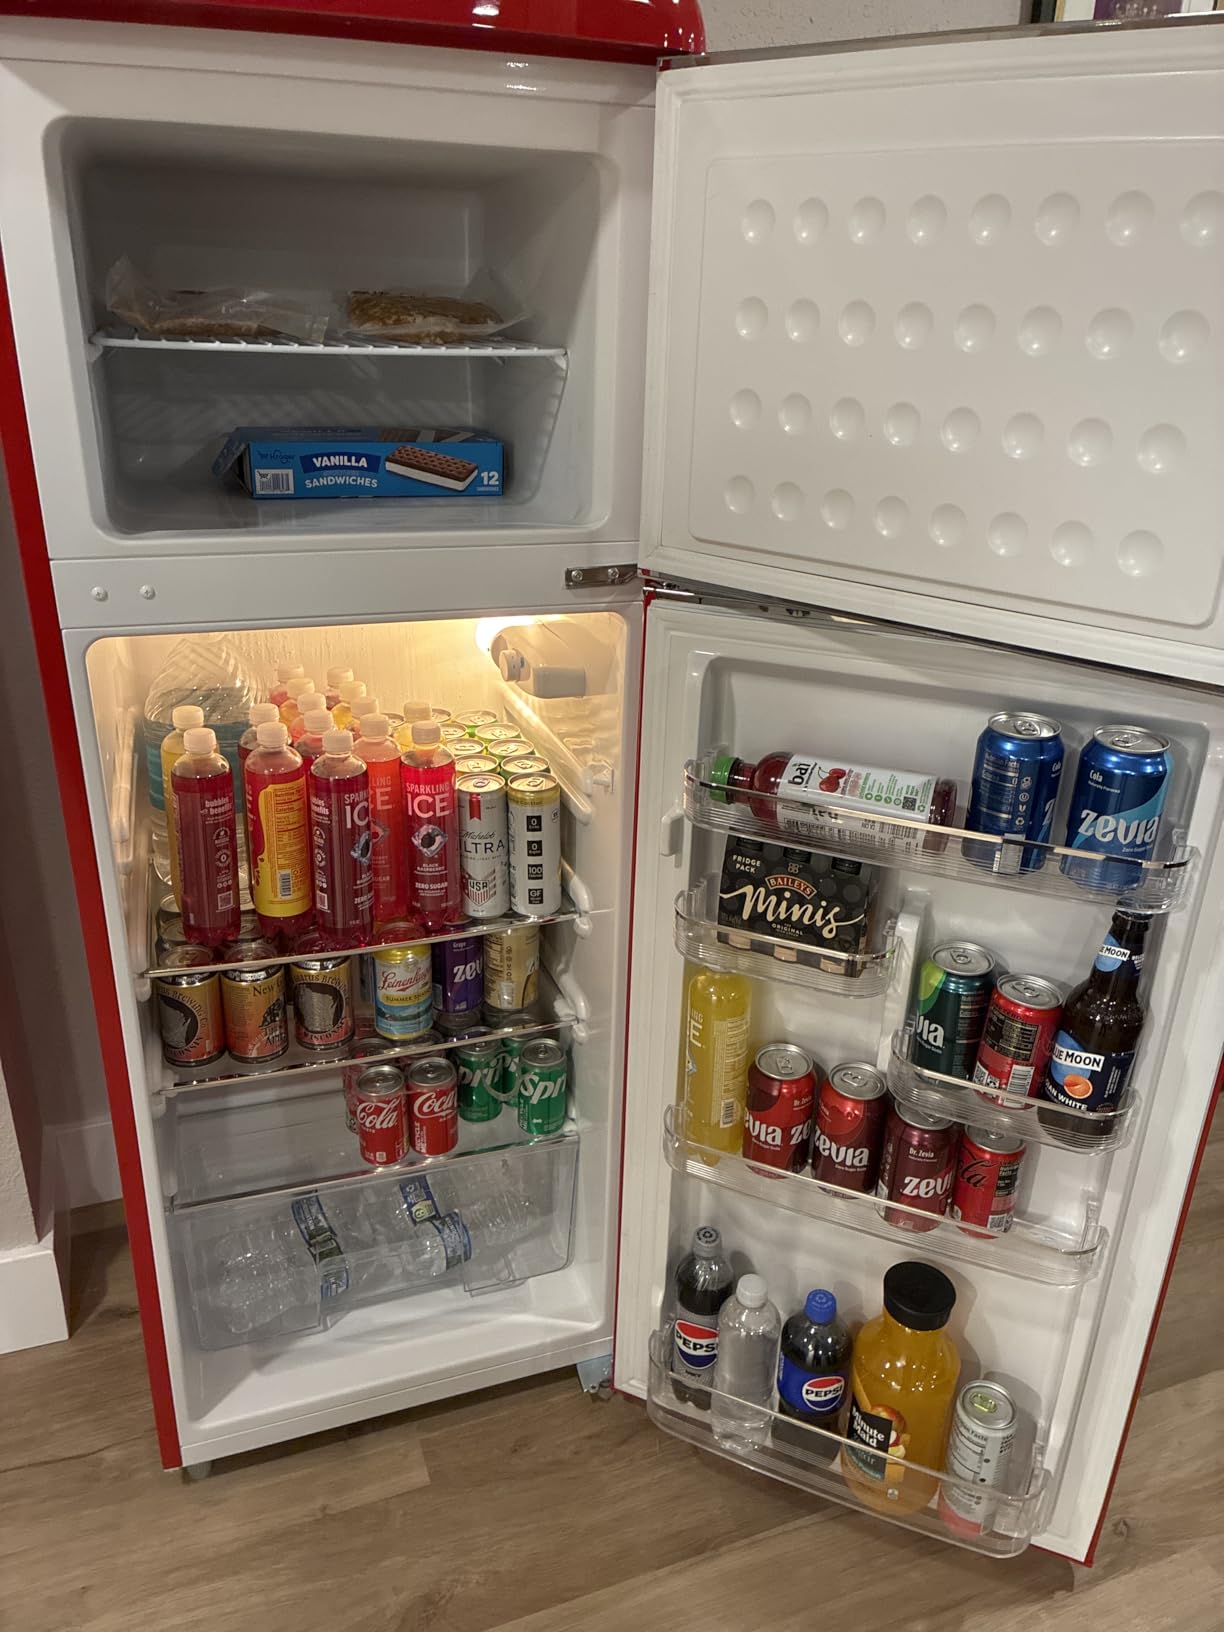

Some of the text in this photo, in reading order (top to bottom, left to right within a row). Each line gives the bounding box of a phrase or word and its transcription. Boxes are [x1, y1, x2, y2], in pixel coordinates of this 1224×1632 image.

[312, 455, 368, 468] VANILLA
[304, 476, 378, 488] SANDWICHES
[480, 471, 500, 486] 12
[788, 762, 811, 786] bai
[1089, 770, 1103, 782] Cola
[406, 782, 451, 798] SPARKLING
[407, 792, 451, 818] ICE
[344, 802, 370, 829] IC
[531, 818, 538, 826] 0
[1078, 808, 1160, 846] zevia
[463, 839, 506, 854] LTRA
[532, 843, 538, 851] 0
[732, 854, 762, 868] FRIDGE
[736, 863, 756, 874] PACK
[528, 866, 543, 874] 100
[430, 882, 448, 890] SUGAR
[469, 880, 489, 892] USA
[769, 876, 814, 897] BAILEYS
[721, 885, 865, 939] Minis
[772, 923, 804, 936] ORIGINAL
[1104, 946, 1128, 959] MOON
[252, 984, 274, 997] New
[1064, 1052, 1103, 1068] MOON
[1058, 1096, 1088, 1111] WHITE
[356, 1096, 401, 1130] Cola
[744, 1107, 783, 1146] evia
[908, 1147, 934, 1159] Dr. Zevia
[676, 1332, 718, 1353] PEPS
[804, 1384, 843, 1398] PEPSI
[852, 1406, 885, 1442] Minute
[853, 1421, 878, 1448] Maid
